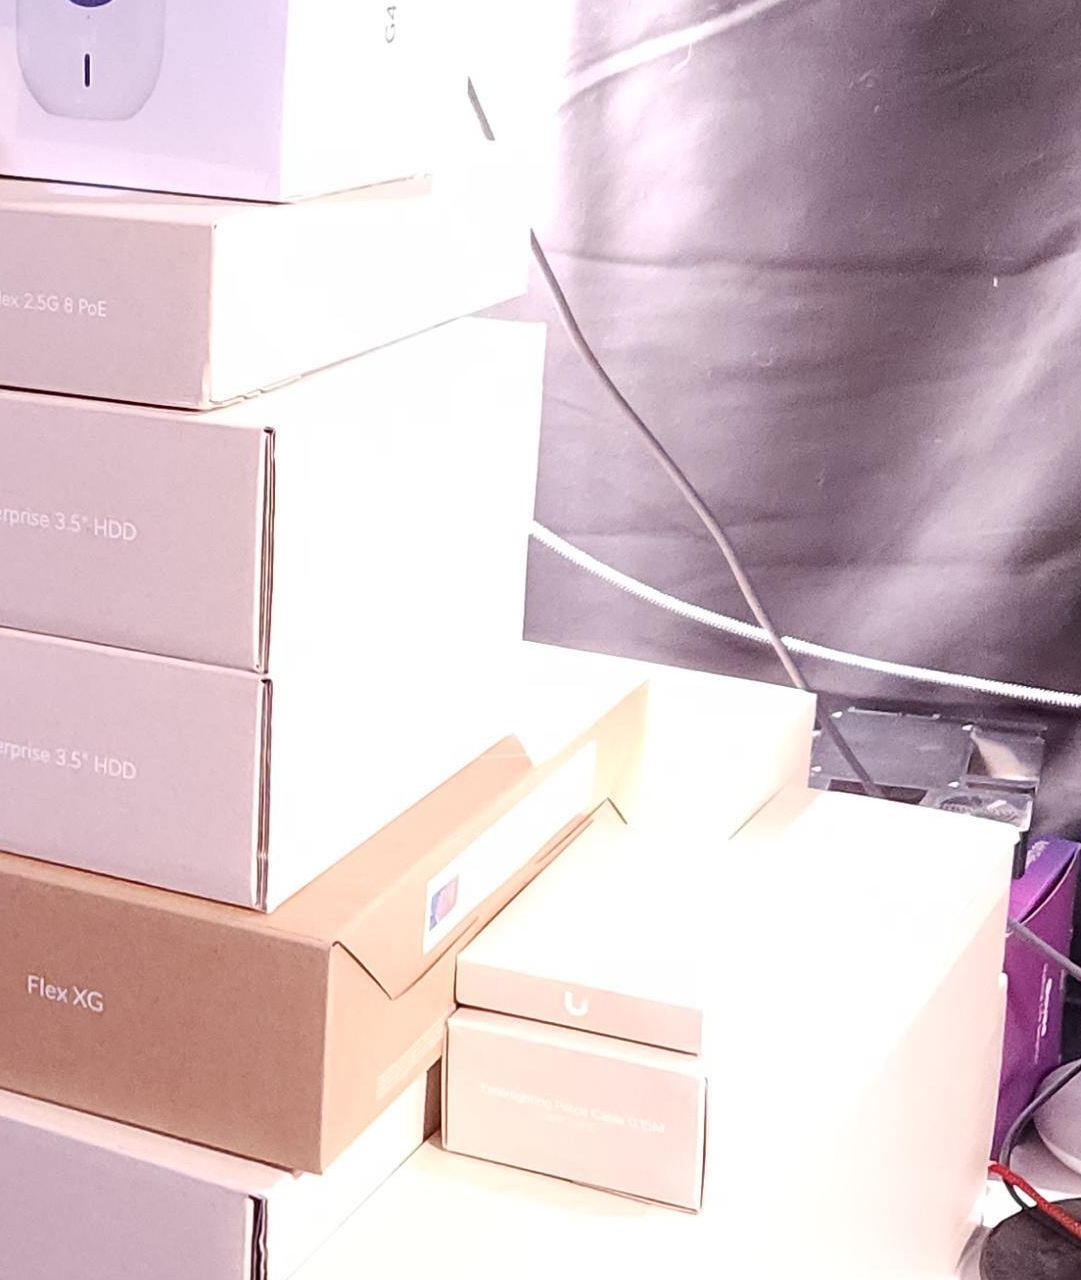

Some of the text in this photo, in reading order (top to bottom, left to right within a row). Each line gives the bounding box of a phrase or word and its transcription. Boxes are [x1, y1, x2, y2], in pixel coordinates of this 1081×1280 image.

[384, 5, 398, 45] G4
[23, 292, 60, 313] 2.5G
[65, 296, 74, 313] 8
[79, 297, 107, 317] PoE
[94, 517, 137, 541] HDD
[94, 754, 137, 780] HDD
[27, 974, 105, 1013] Flex XG
